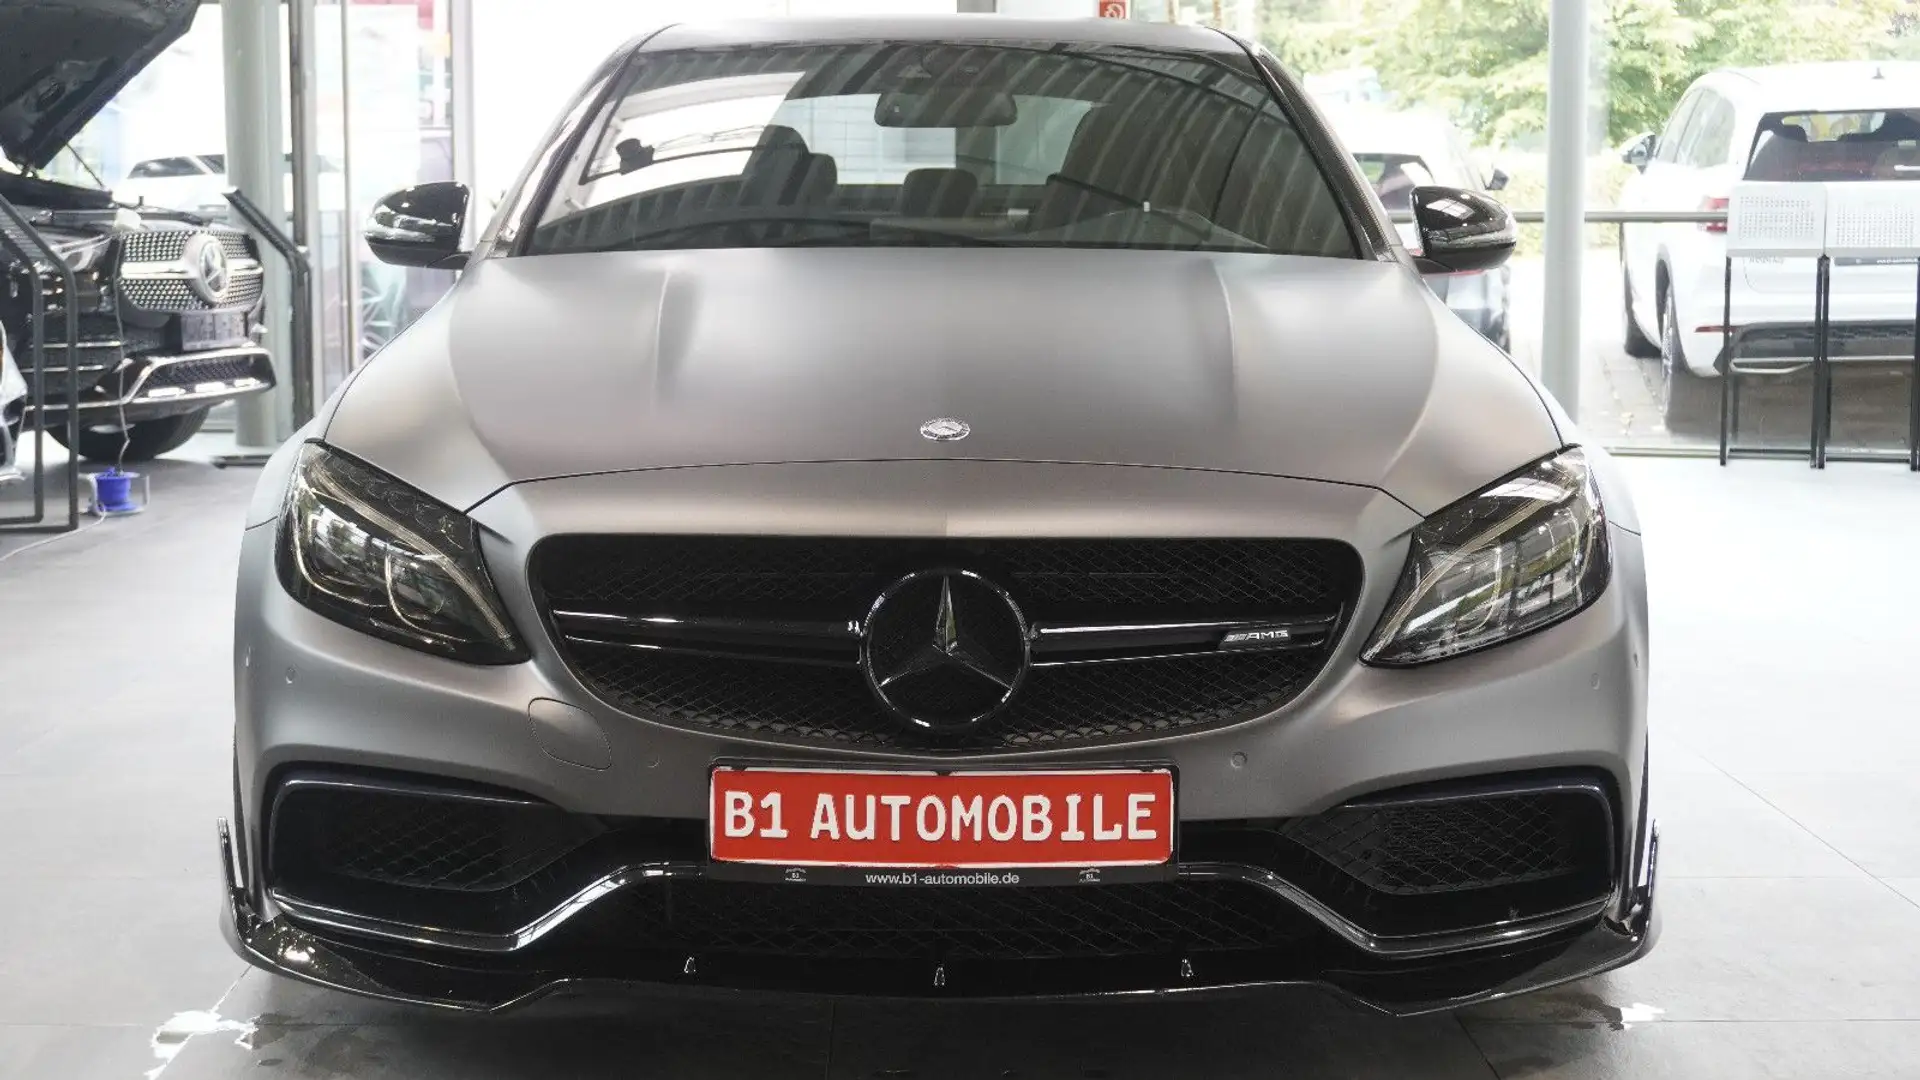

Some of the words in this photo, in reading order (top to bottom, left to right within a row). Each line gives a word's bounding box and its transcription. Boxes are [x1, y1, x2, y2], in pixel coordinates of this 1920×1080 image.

[1245, 630, 1289, 640] AMG
[725, 791, 788, 838] B1
[810, 793, 1157, 841] AUTOMOBILE
[865, 872, 1020, 885] www.b1-automobile.de
